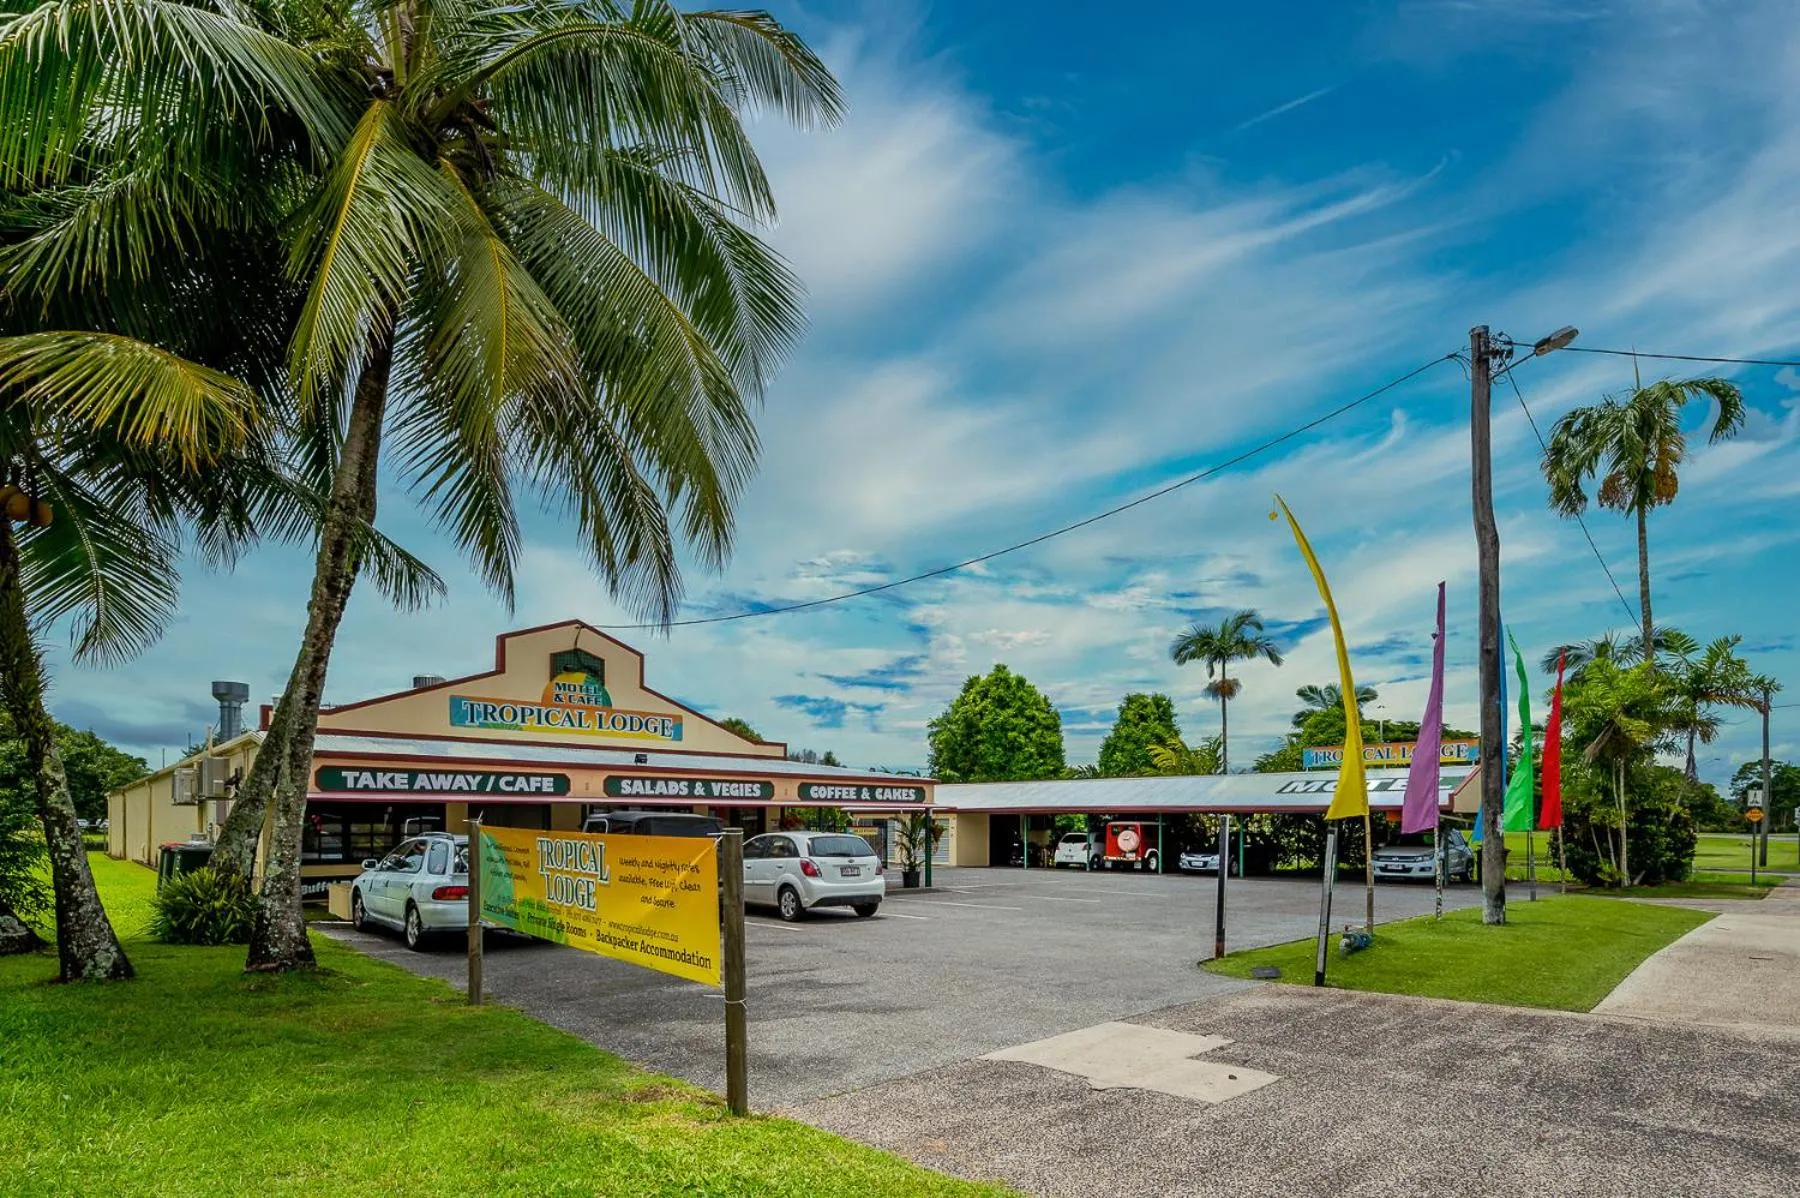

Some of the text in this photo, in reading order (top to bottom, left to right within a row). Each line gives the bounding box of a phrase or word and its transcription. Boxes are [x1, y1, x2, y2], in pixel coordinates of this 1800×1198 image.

[553, 693, 564, 704] &
[555, 682, 600, 694] MOTEL
[461, 700, 673, 738] TROPICAL LODGE
[1312, 742, 1468, 764] TROCAL LGE
[342, 771, 554, 792] TAKE AWAY / CAFE
[620, 779, 761, 797] SALADS & VEGIES
[809, 785, 916, 801] COFFEE & CAKES
[537, 837, 610, 884] TROPICAL
[545, 872, 597, 912] LODGE
[565, 921, 587, 937] Rooms
[596, 928, 638, 951] Backpacker
[640, 940, 712, 969] Accommodation
